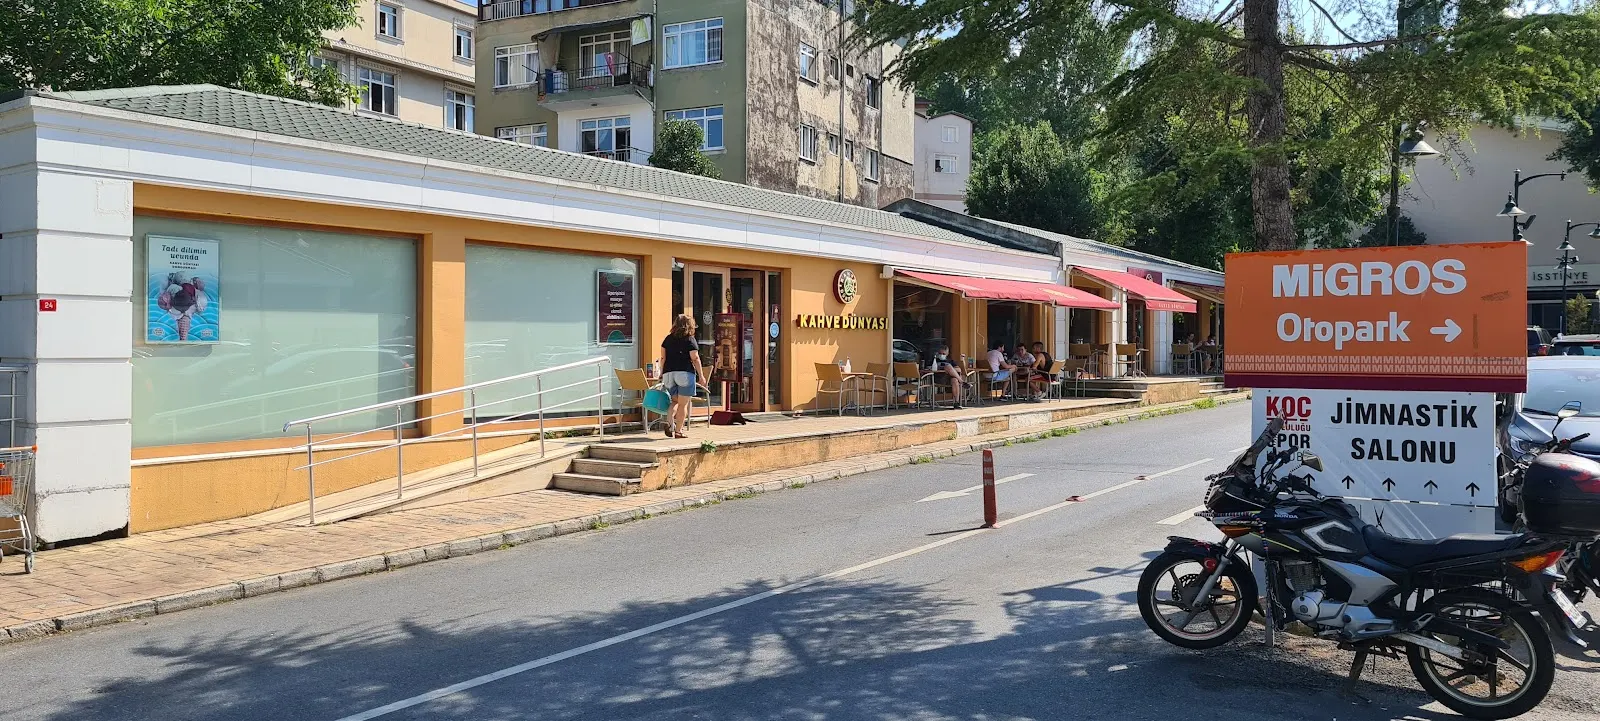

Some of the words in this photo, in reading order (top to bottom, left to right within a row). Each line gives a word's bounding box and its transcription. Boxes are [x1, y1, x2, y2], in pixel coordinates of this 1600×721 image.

[161, 244, 178, 252] Tadı
[180, 246, 207, 255] dilimin
[799, 313, 840, 329] KAHVE
[842, 313, 889, 330] DÜNYASI
[1276, 311, 1411, 350] Otopark
[1330, 397, 1478, 429] JİMNASTİK
[1351, 437, 1456, 464] SALONU
